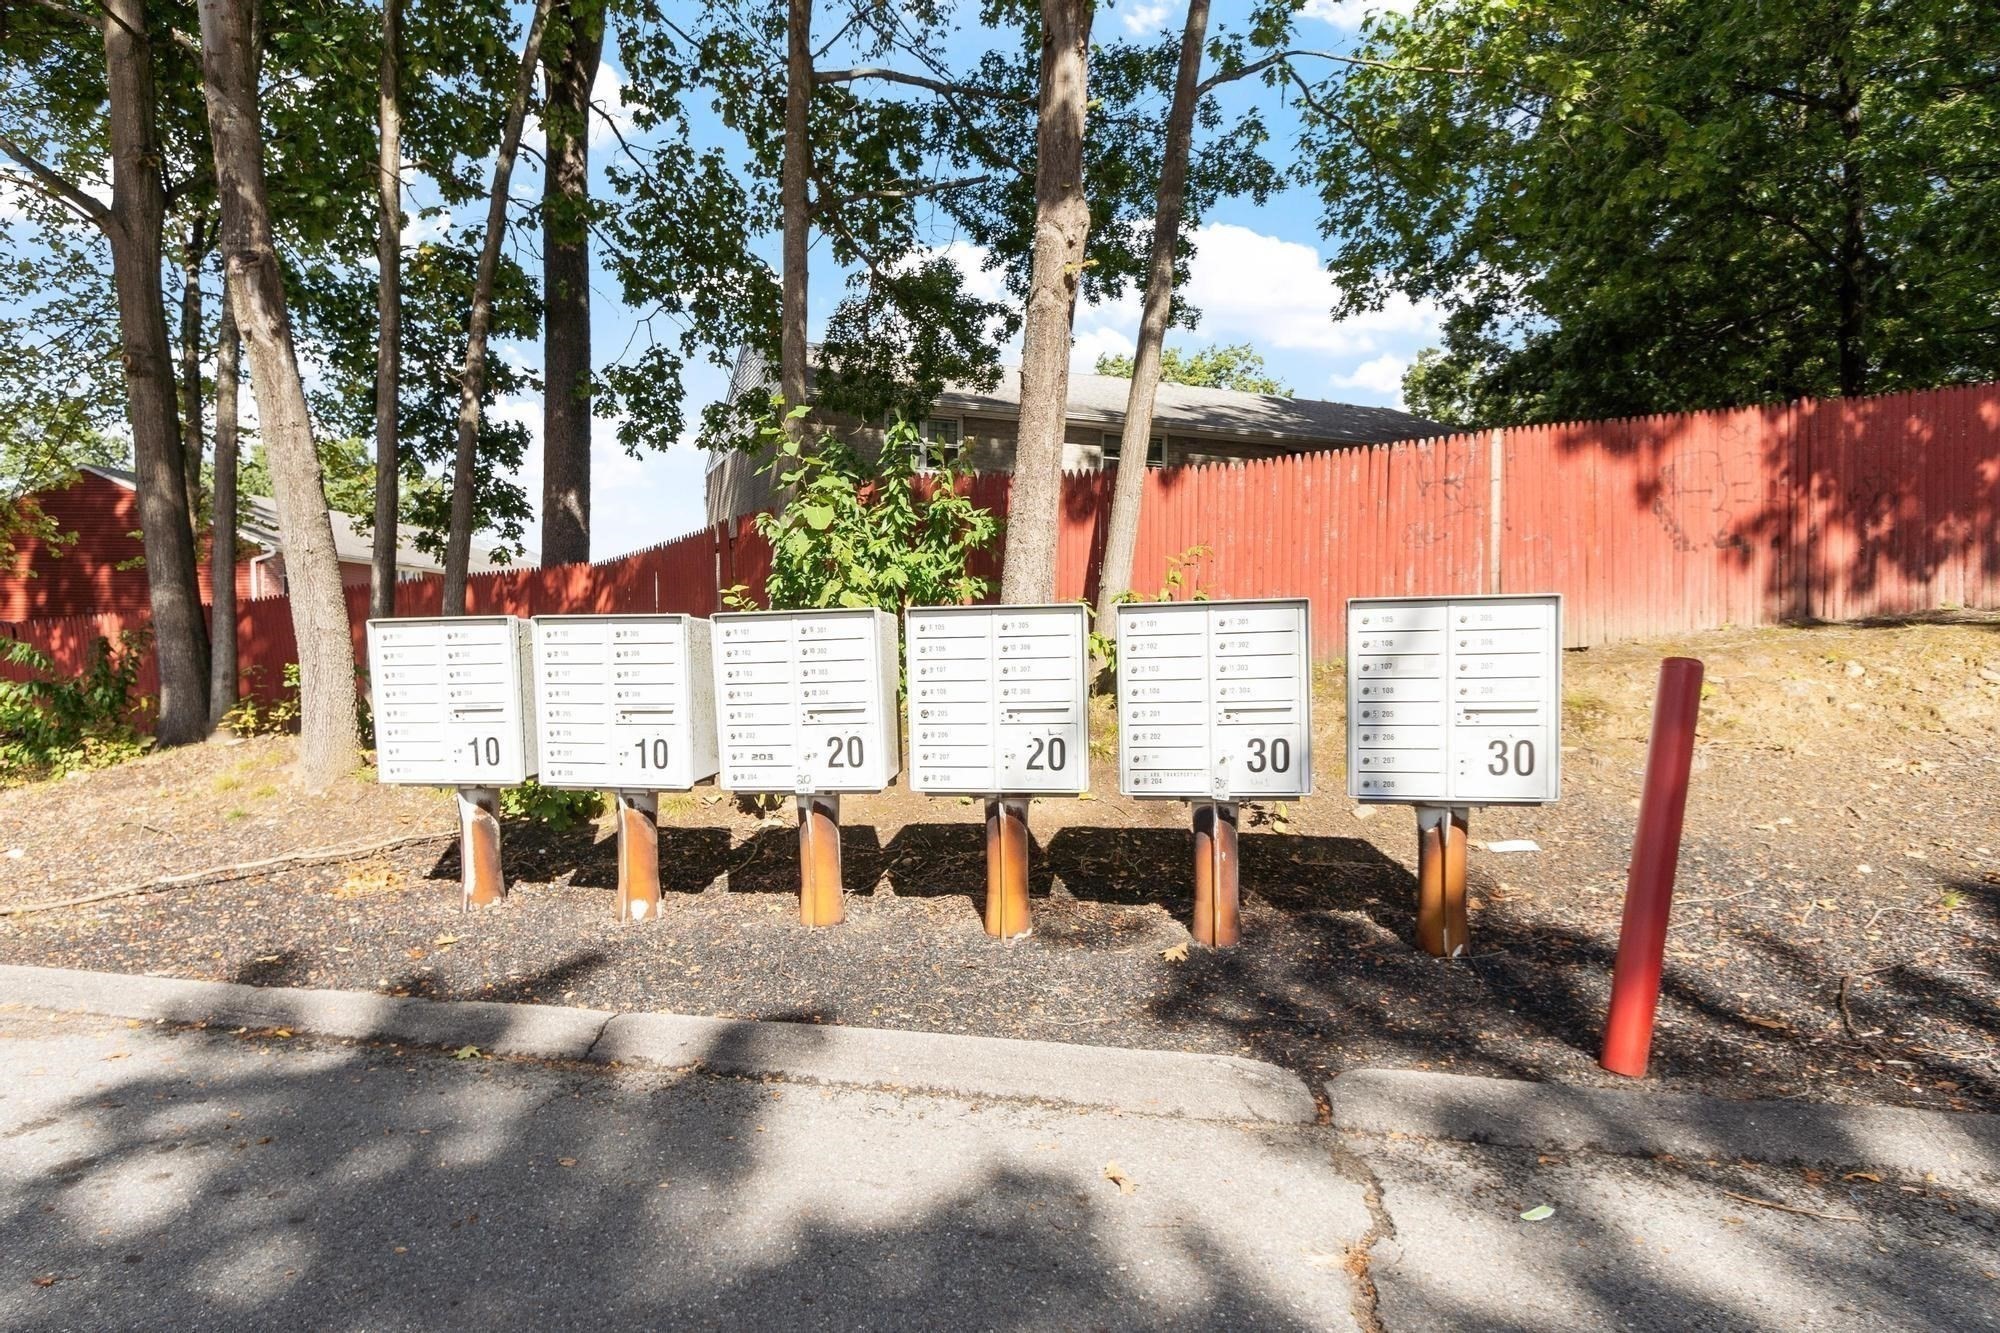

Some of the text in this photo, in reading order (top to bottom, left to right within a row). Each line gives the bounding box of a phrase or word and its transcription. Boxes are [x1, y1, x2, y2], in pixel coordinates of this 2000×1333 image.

[1381, 615, 1394, 623] 105
[1381, 639, 1394, 647] 106
[1380, 662, 1393, 670] 107
[1381, 686, 1394, 694] 108
[1381, 710, 1394, 718] 205
[1382, 733, 1395, 741] 206
[468, 736, 500, 767] 10
[634, 738, 668, 770] 10
[826, 735, 864, 768] 20
[1026, 737, 1066, 772] 20
[1246, 738, 1290, 773] 30
[751, 753, 774, 761] 203
[1382, 756, 1395, 764] 207
[1487, 739, 1535, 776] 30
[1382, 780, 1395, 788] 208
